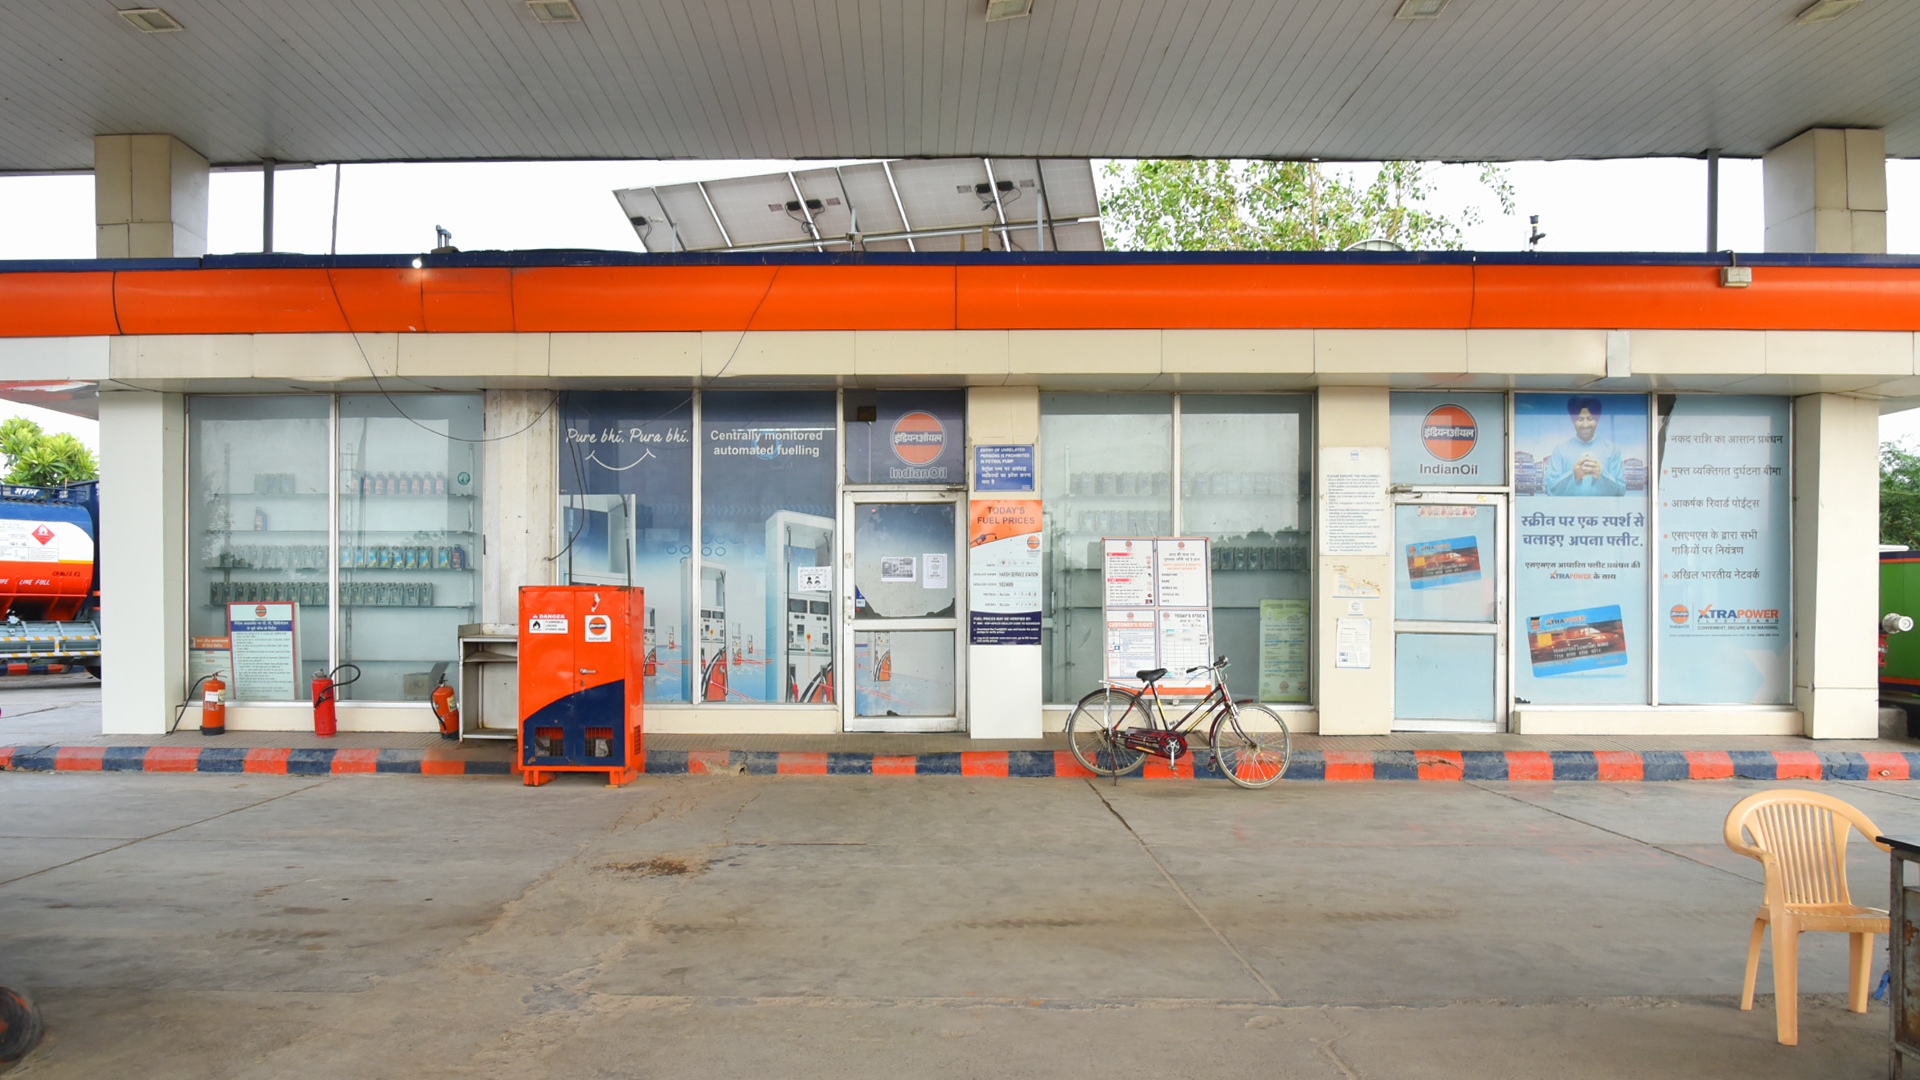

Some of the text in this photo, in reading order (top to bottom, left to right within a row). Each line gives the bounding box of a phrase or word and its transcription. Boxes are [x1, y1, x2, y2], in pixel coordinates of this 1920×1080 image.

[566, 428, 689, 443] Pure bhi. Pura bhi.
[710, 429, 823, 443] Centrally monitored
[1424, 426, 1475, 439] इंडियनऑयल
[1671, 435, 1691, 444] नकद
[1694, 433, 1712, 444] राशि
[1715, 435, 1725, 444] का
[1728, 435, 1756, 444] आसान
[713, 445, 820, 457] automated fuelling
[889, 466, 948, 479] IndianOil
[1419, 463, 1478, 476] IndianOil
[1693, 464, 1731, 476] व्यक्तिगत
[1733, 464, 1761, 479] दुर्घटना
[1763, 465, 1782, 476] बीमा
[1671, 497, 1703, 508] आकर्षक
[1706, 496, 1730, 508] रिवार्ड
[987, 506, 1025, 514] TODAY'S
[977, 516, 1035, 524] FUEL PRICES
[1521, 511, 1645, 529] स्क्रीन पर एक स्पर्श से
[1523, 534, 1564, 547] चलाइए
[1568, 535, 1604, 547] अपना
[1671, 528, 1758, 541] एसएमएस के द्वारा सभी
[1702, 546, 1712, 555] पर
[1715, 543, 1744, 555] नियंत्रण
[1549, 570, 1592, 579] XTRAPOWER
[1672, 568, 1760, 580] अखिल भारतीय नेटवर्क
[1698, 604, 1779, 619] XTRAPOWER
